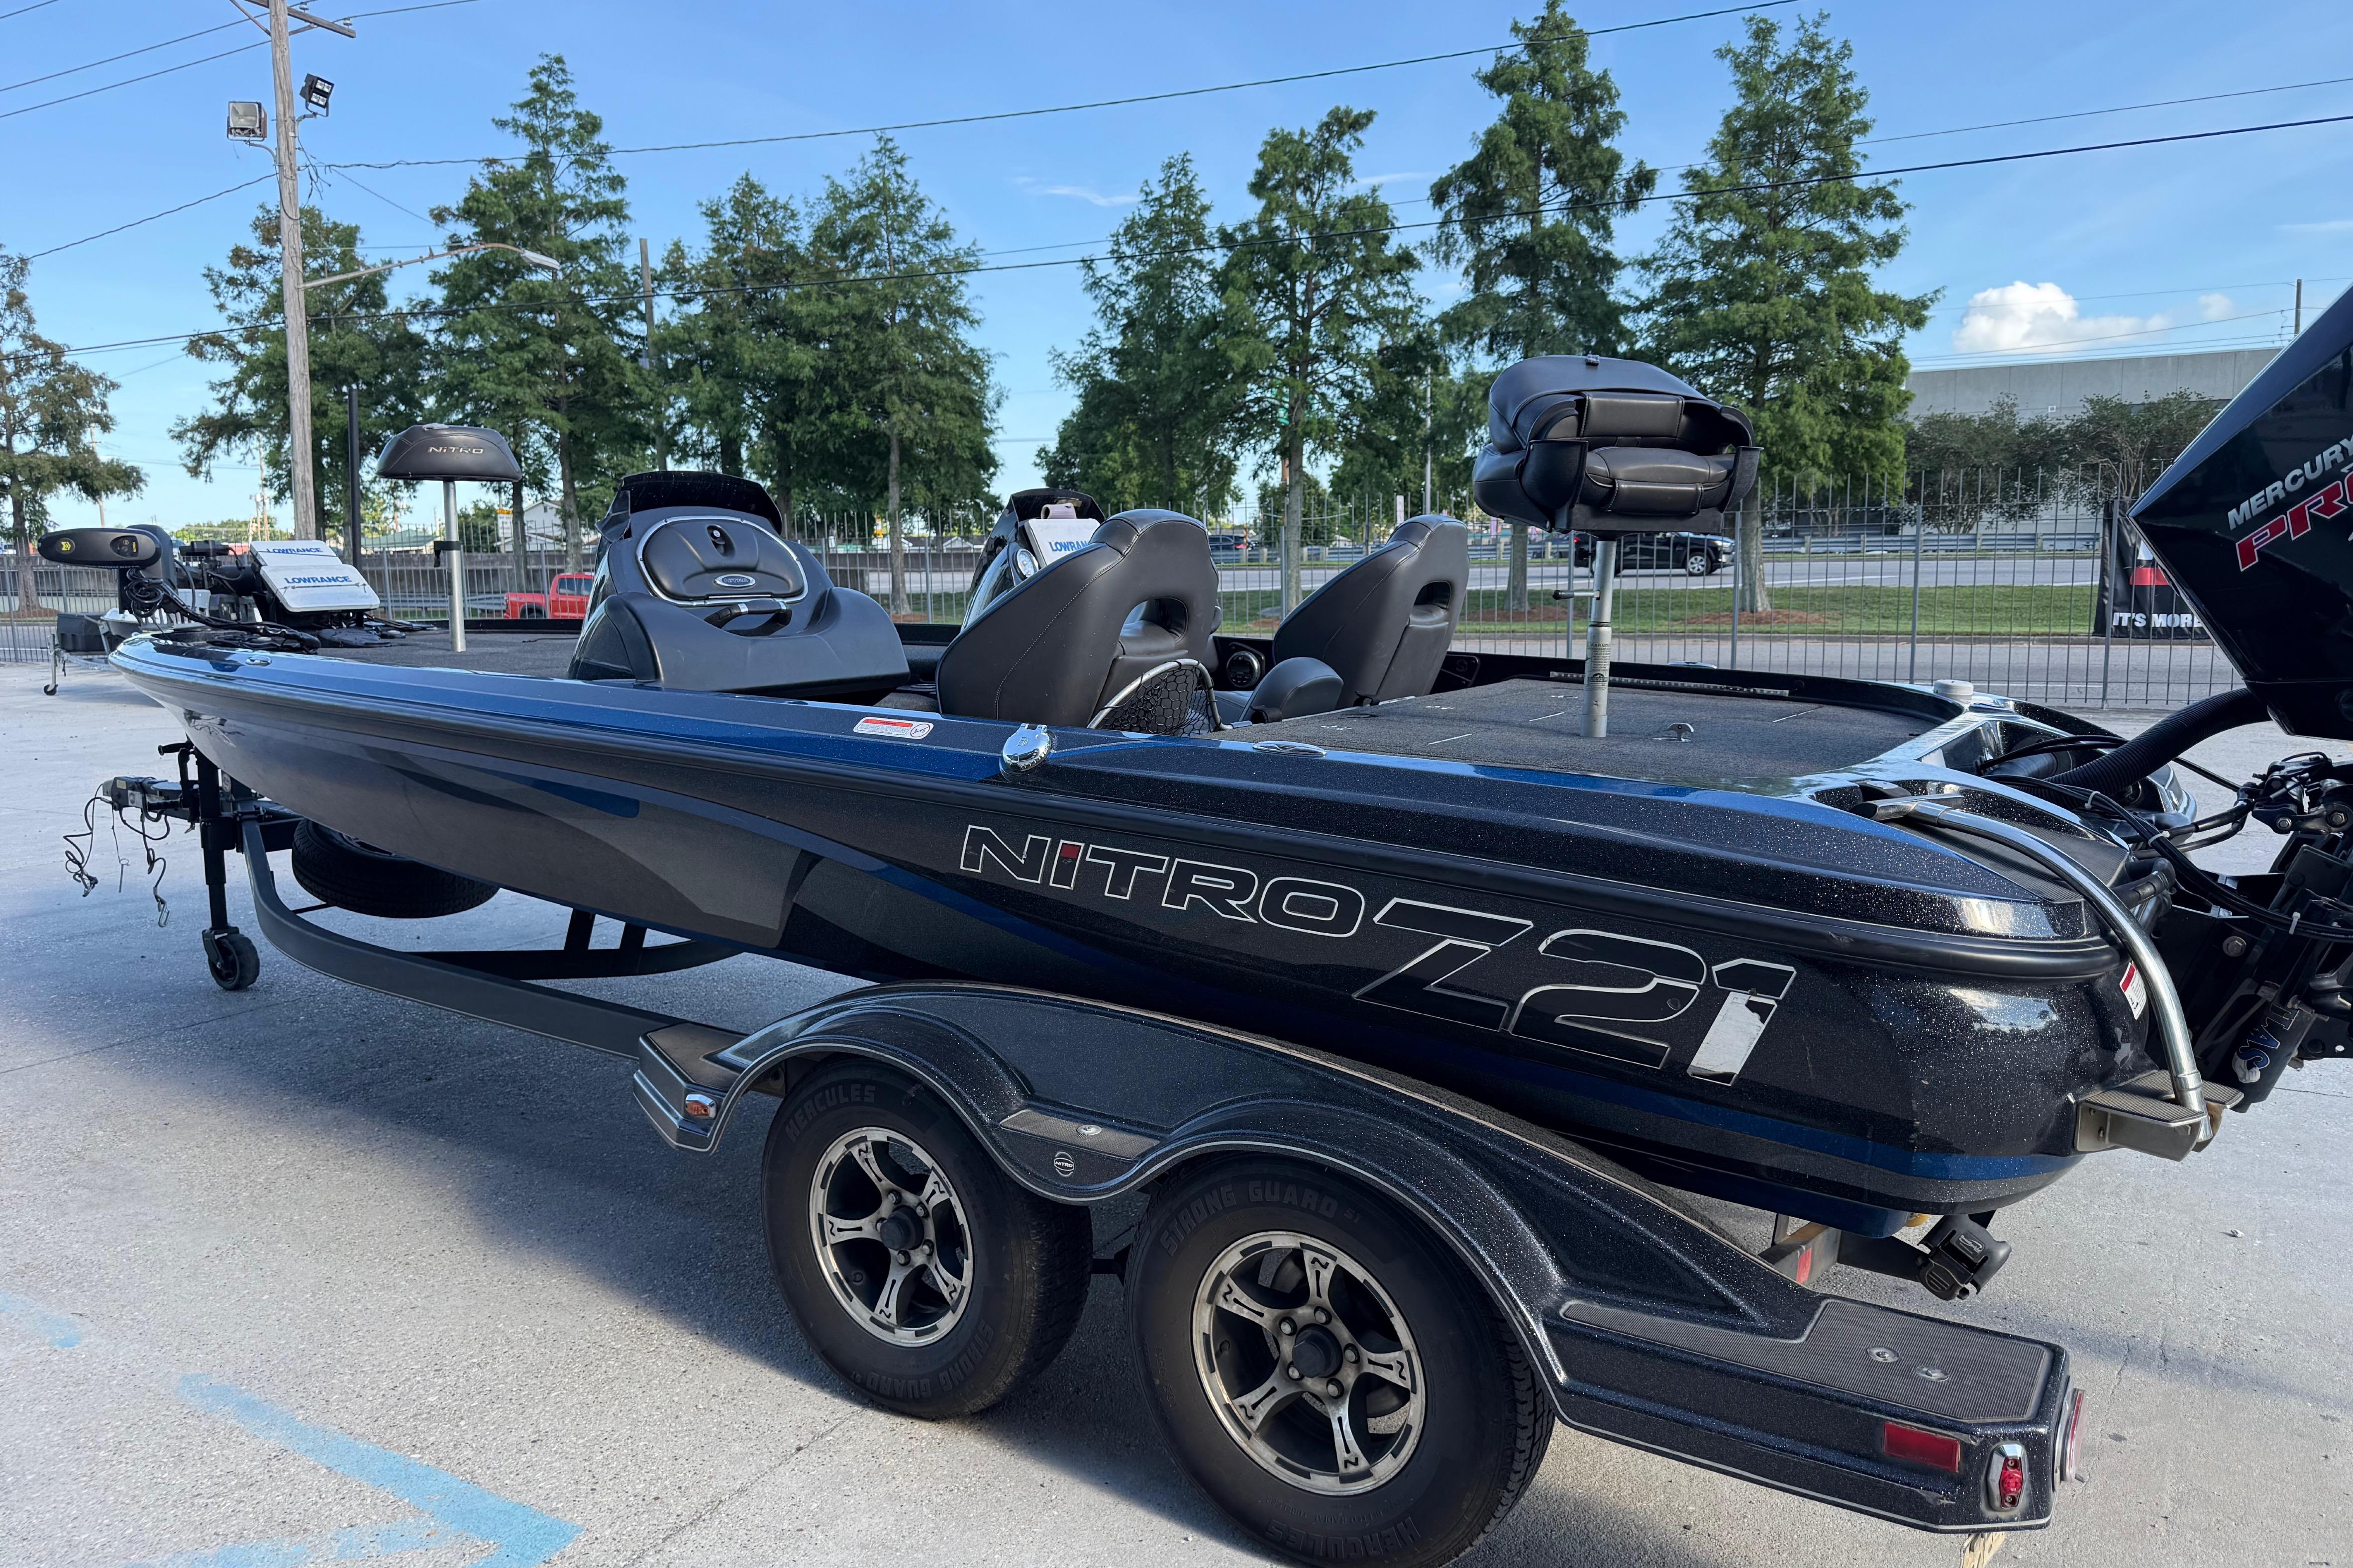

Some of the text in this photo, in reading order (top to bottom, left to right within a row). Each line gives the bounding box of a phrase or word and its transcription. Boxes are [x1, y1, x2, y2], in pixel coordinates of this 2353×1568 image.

[2113, 612, 2147, 627] IT'S
[785, 1083, 877, 1144] HERCULES
[1159, 1184, 1238, 1257] STRONG
[1248, 1179, 1339, 1219] GUARD
[1344, 1207, 1364, 1224] ST
[938, 1318, 994, 1392] STRONG
[866, 1371, 932, 1399] GUARD
[1265, 1516, 1422, 1560] HERCULES
